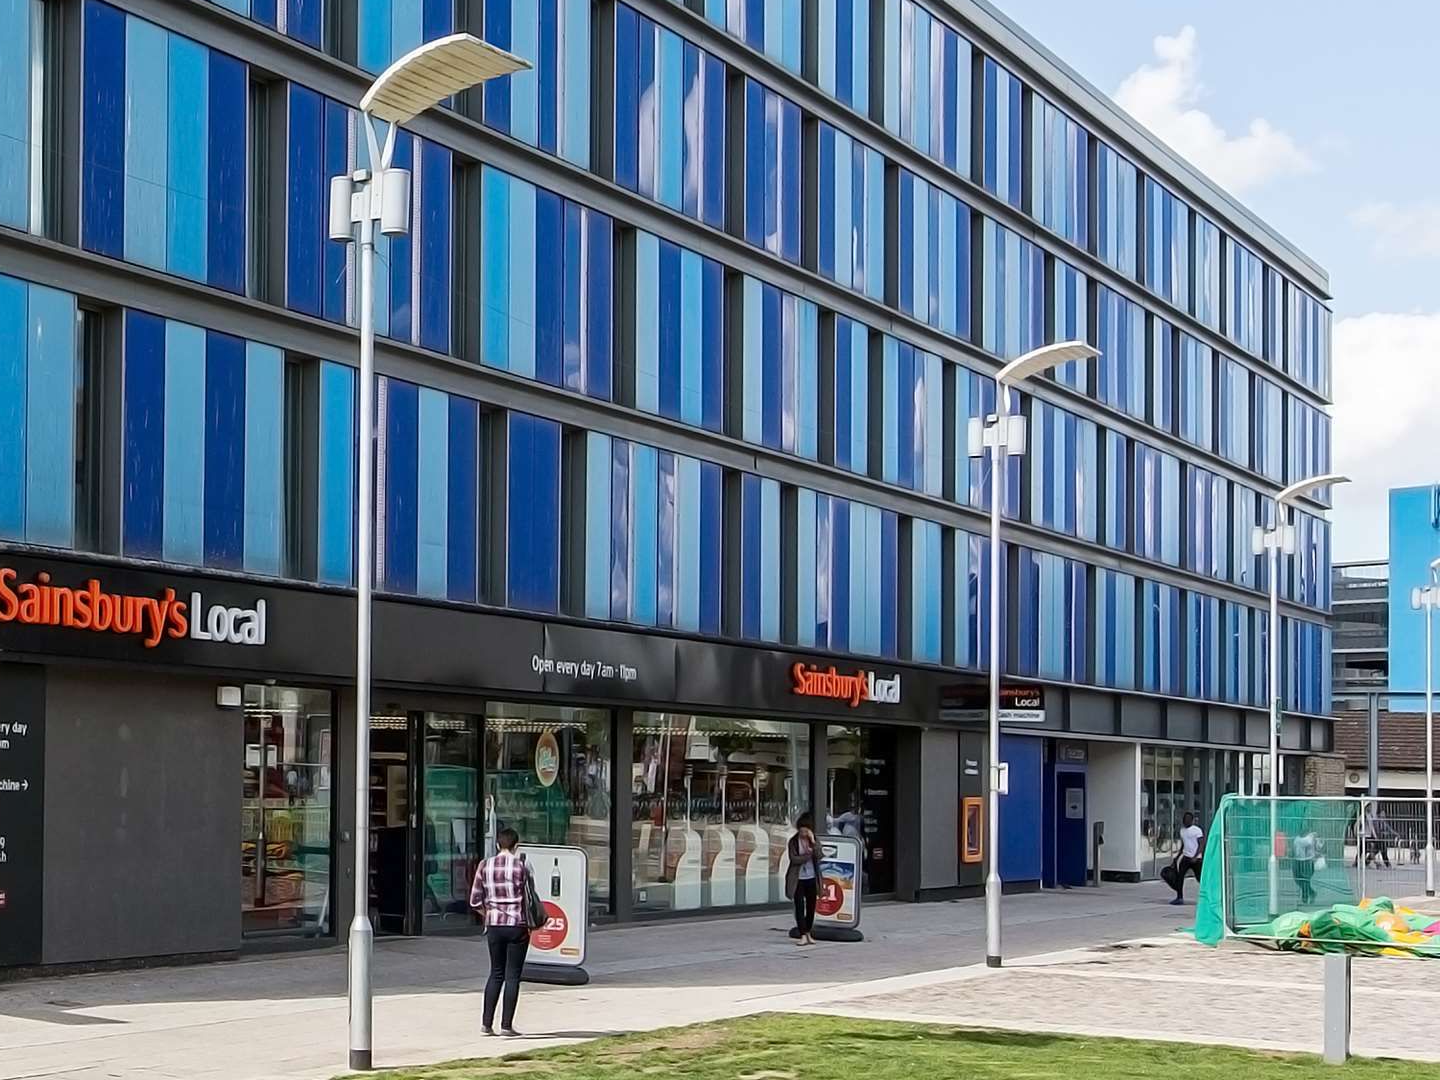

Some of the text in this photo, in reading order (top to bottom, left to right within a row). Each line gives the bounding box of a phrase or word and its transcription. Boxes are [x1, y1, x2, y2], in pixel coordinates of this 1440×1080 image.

[190, 591, 266, 646] Local
[531, 654, 554, 675] Open
[556, 660, 580, 679] every
[580, 660, 596, 680] day
[596, 661, 614, 678] 7am
[792, 662, 901, 708] Sainsbury's Local
[1015, 697, 1040, 707] Local
[12, 721, 28, 736] day
